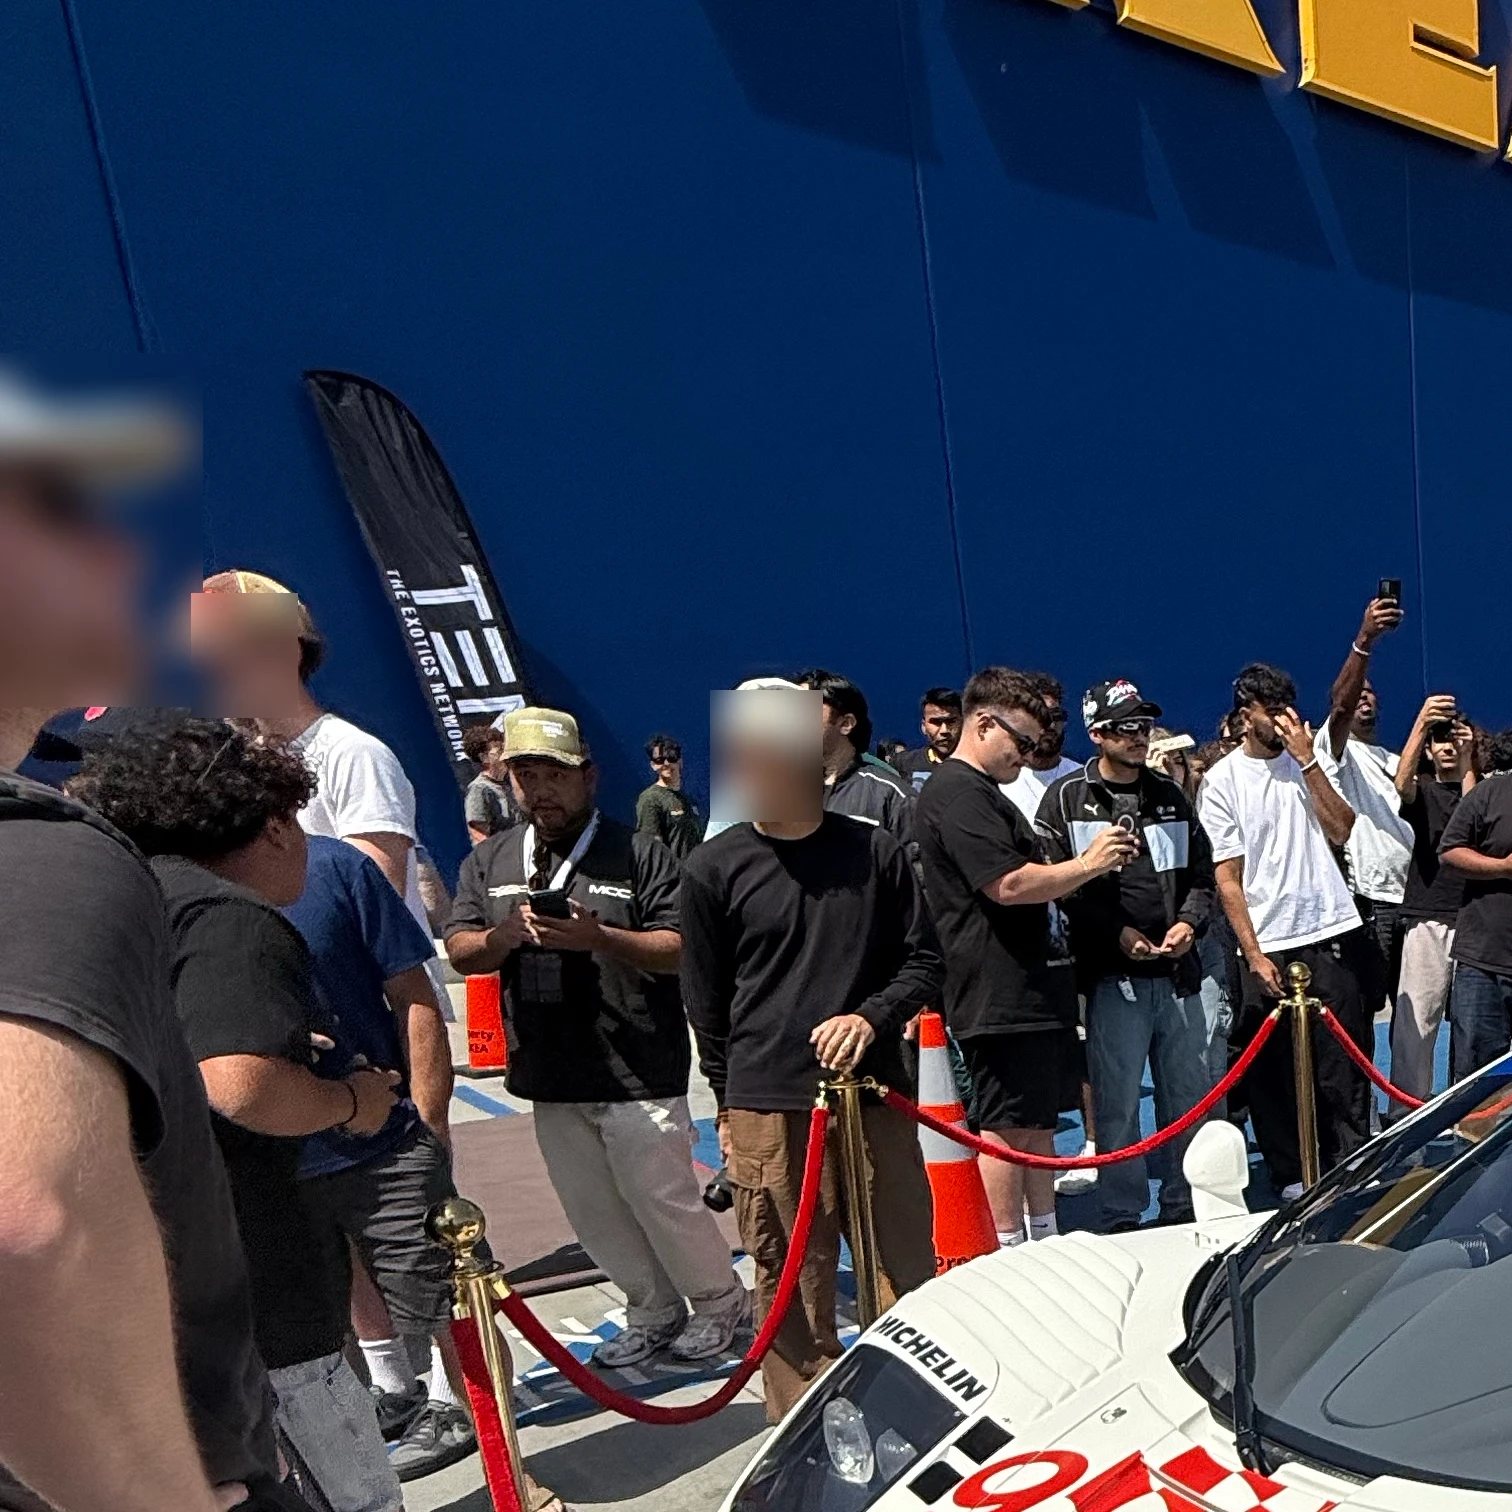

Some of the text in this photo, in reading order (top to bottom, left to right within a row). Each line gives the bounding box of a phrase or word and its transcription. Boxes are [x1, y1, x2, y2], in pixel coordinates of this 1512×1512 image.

[385, 568, 412, 601] THE
[399, 605, 438, 678] EXOTICS
[874, 1314, 988, 1403] MICHELIN
